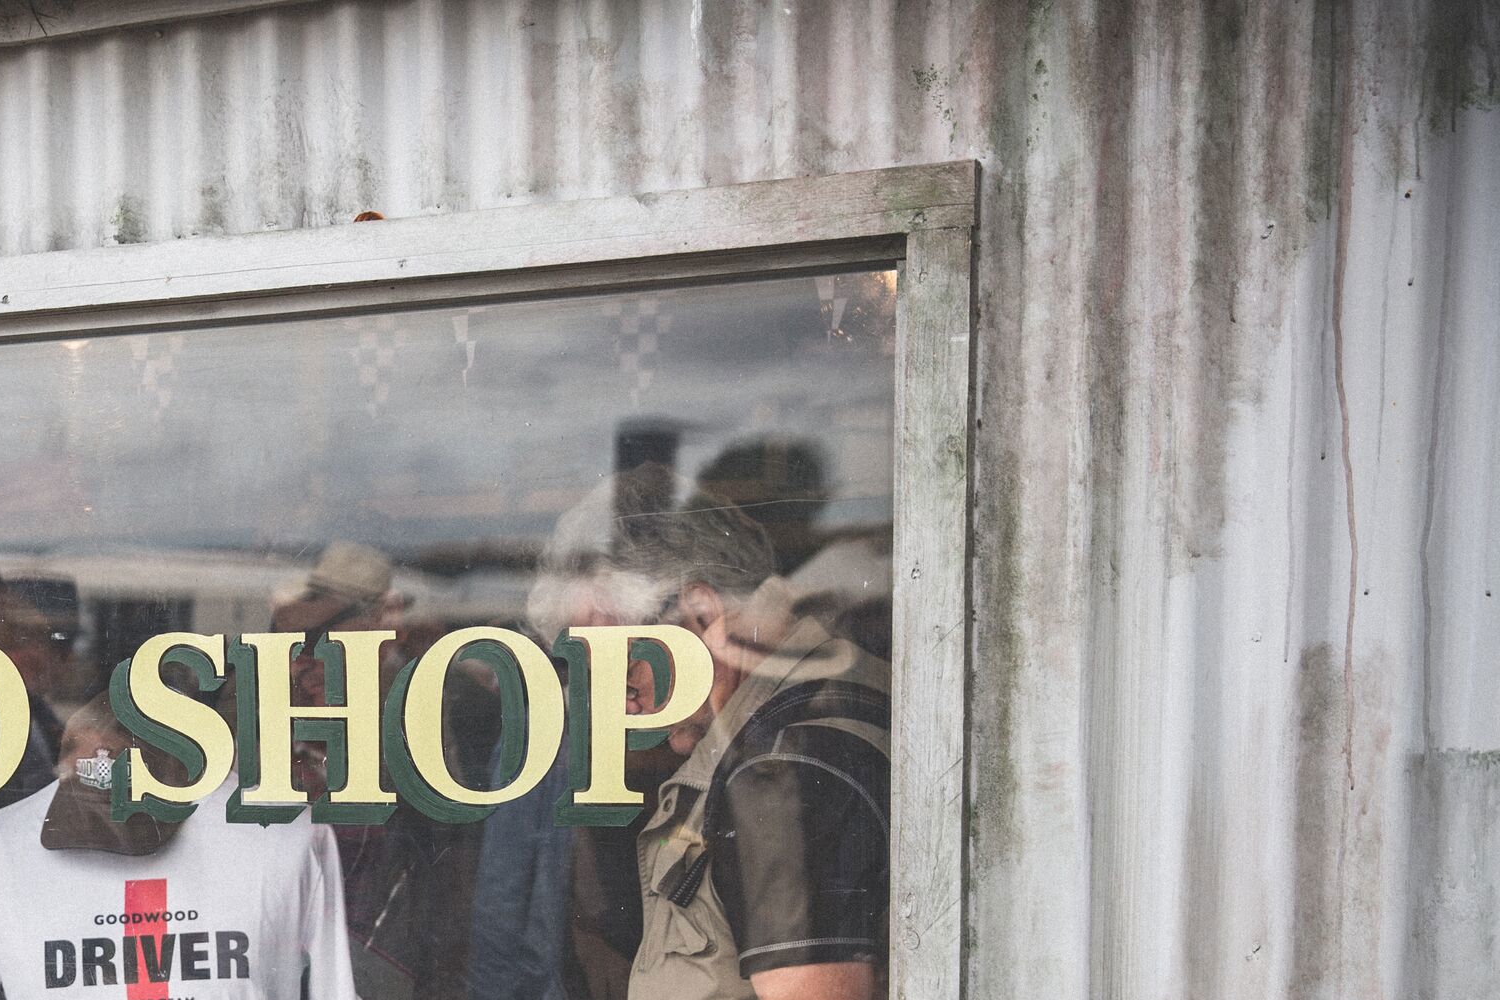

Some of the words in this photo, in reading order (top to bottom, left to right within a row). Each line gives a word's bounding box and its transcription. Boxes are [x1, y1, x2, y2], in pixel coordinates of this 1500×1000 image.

[109, 625, 714, 826] SHOP
[94, 910, 199, 925] GOODWOOD
[44, 930, 250, 989] DRIVER
